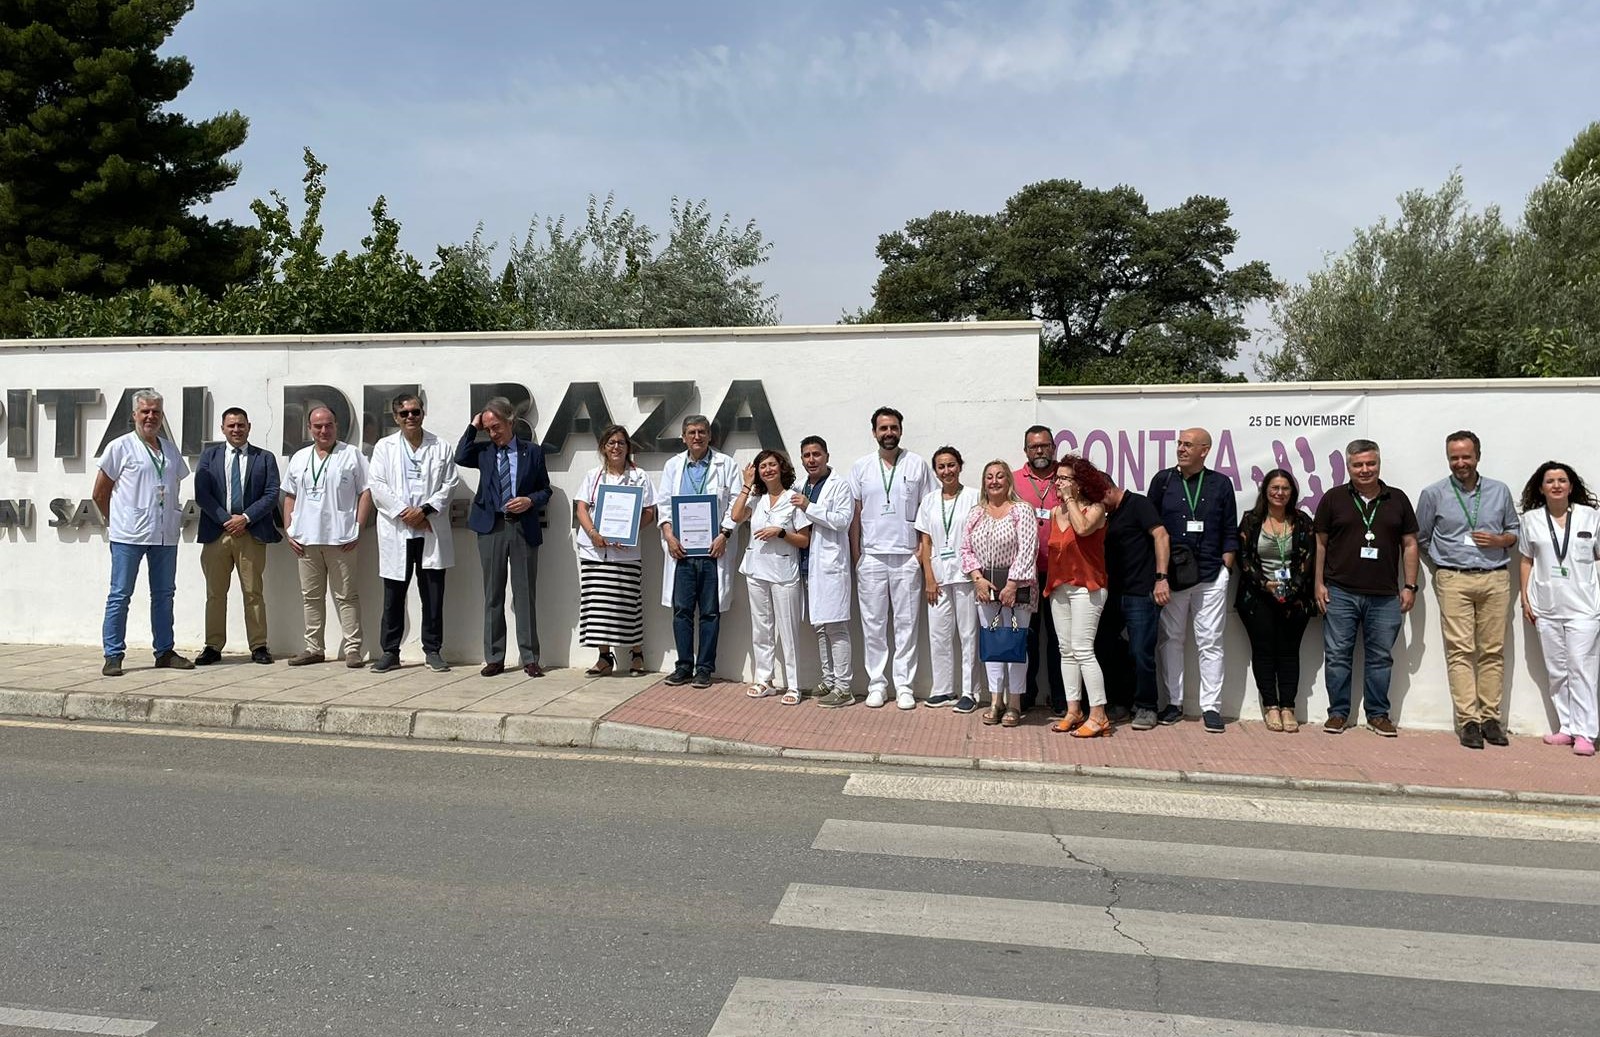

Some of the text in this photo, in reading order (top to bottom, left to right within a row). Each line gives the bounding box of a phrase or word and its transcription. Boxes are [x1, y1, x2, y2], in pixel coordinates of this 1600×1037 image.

[1249, 415, 1356, 427] 25 DE NOVIEMBRE
[1053, 430, 1242, 492] CONTA
